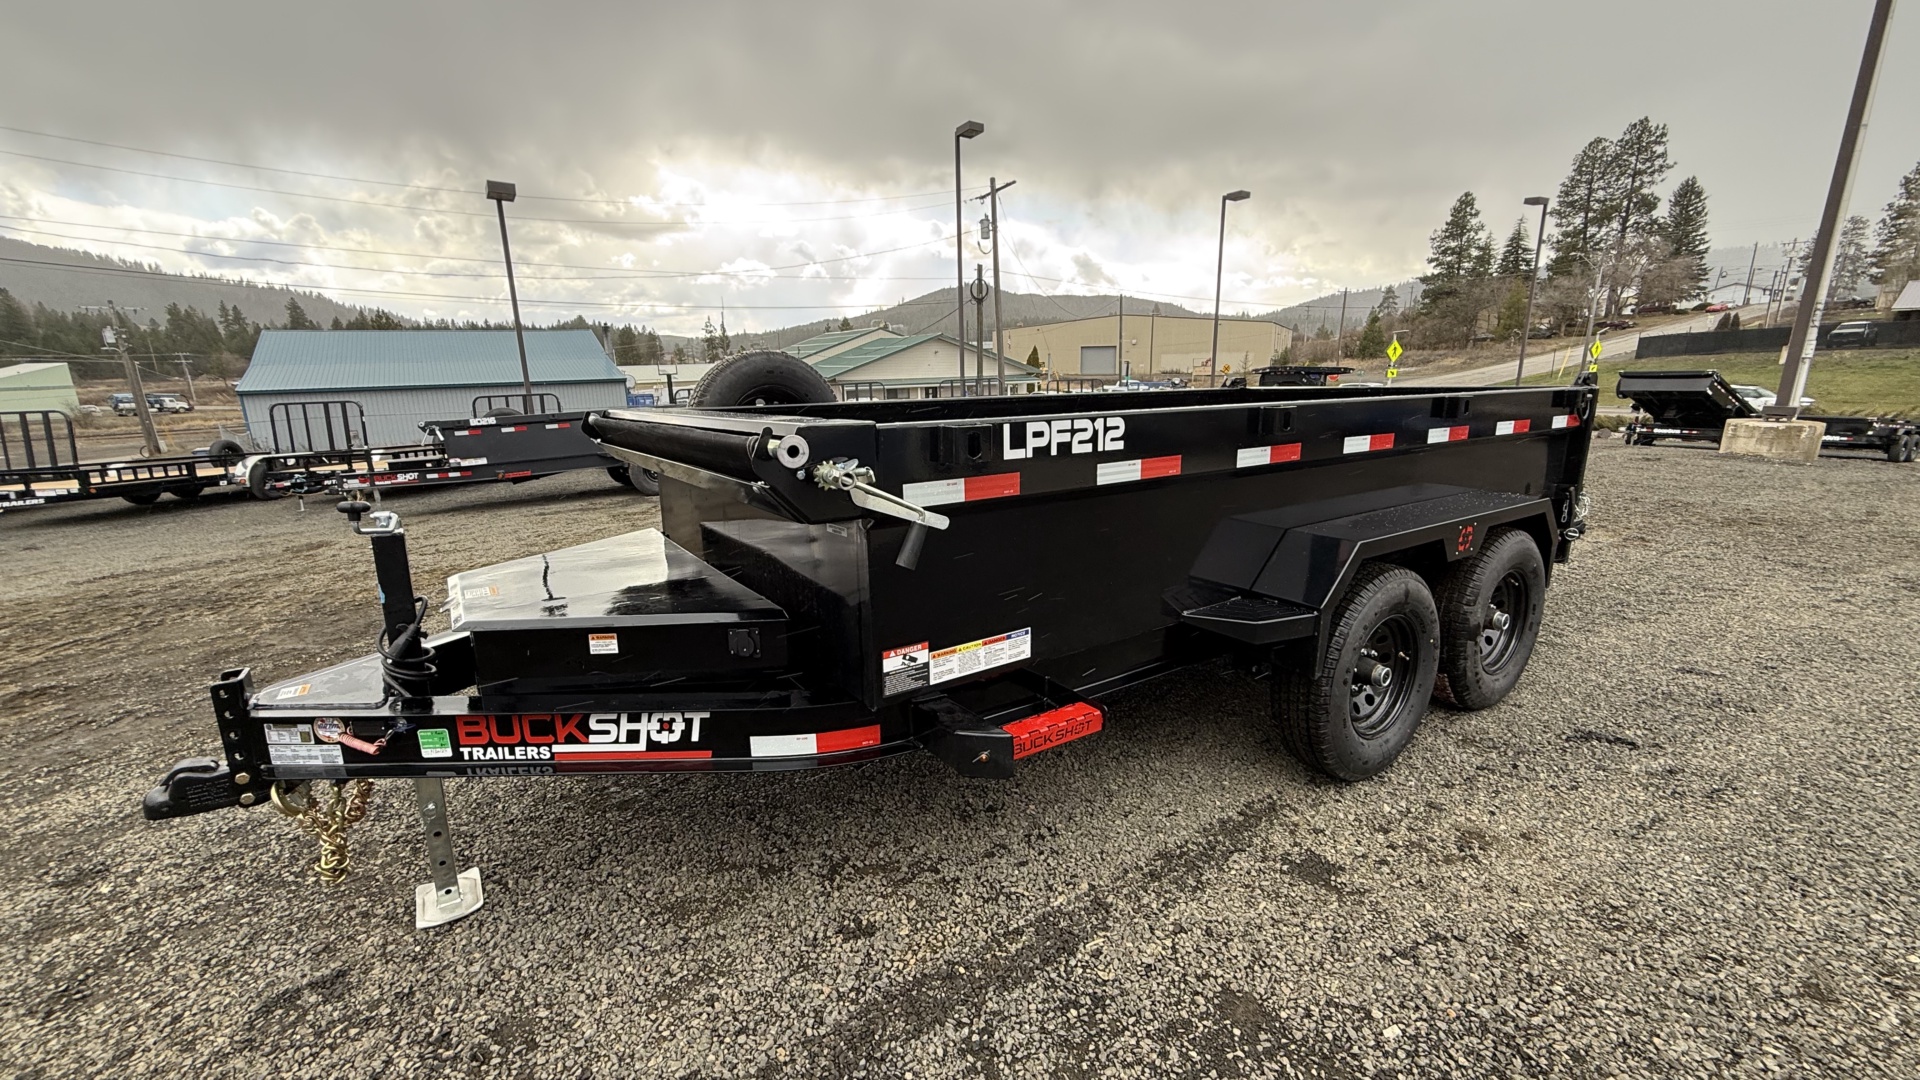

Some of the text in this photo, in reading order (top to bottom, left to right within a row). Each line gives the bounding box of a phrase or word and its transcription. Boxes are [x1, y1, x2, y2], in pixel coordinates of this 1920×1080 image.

[1003, 417, 1125, 460] LPF212
[374, 472, 419, 481] BUCKSHOT
[0, 498, 45, 508] TRAILERS
[896, 644, 922, 655] DANGER
[455, 712, 711, 745] BUCKSHOT
[1014, 720, 1093, 755] BUCKSHOT
[459, 746, 551, 760] TRAILERS
